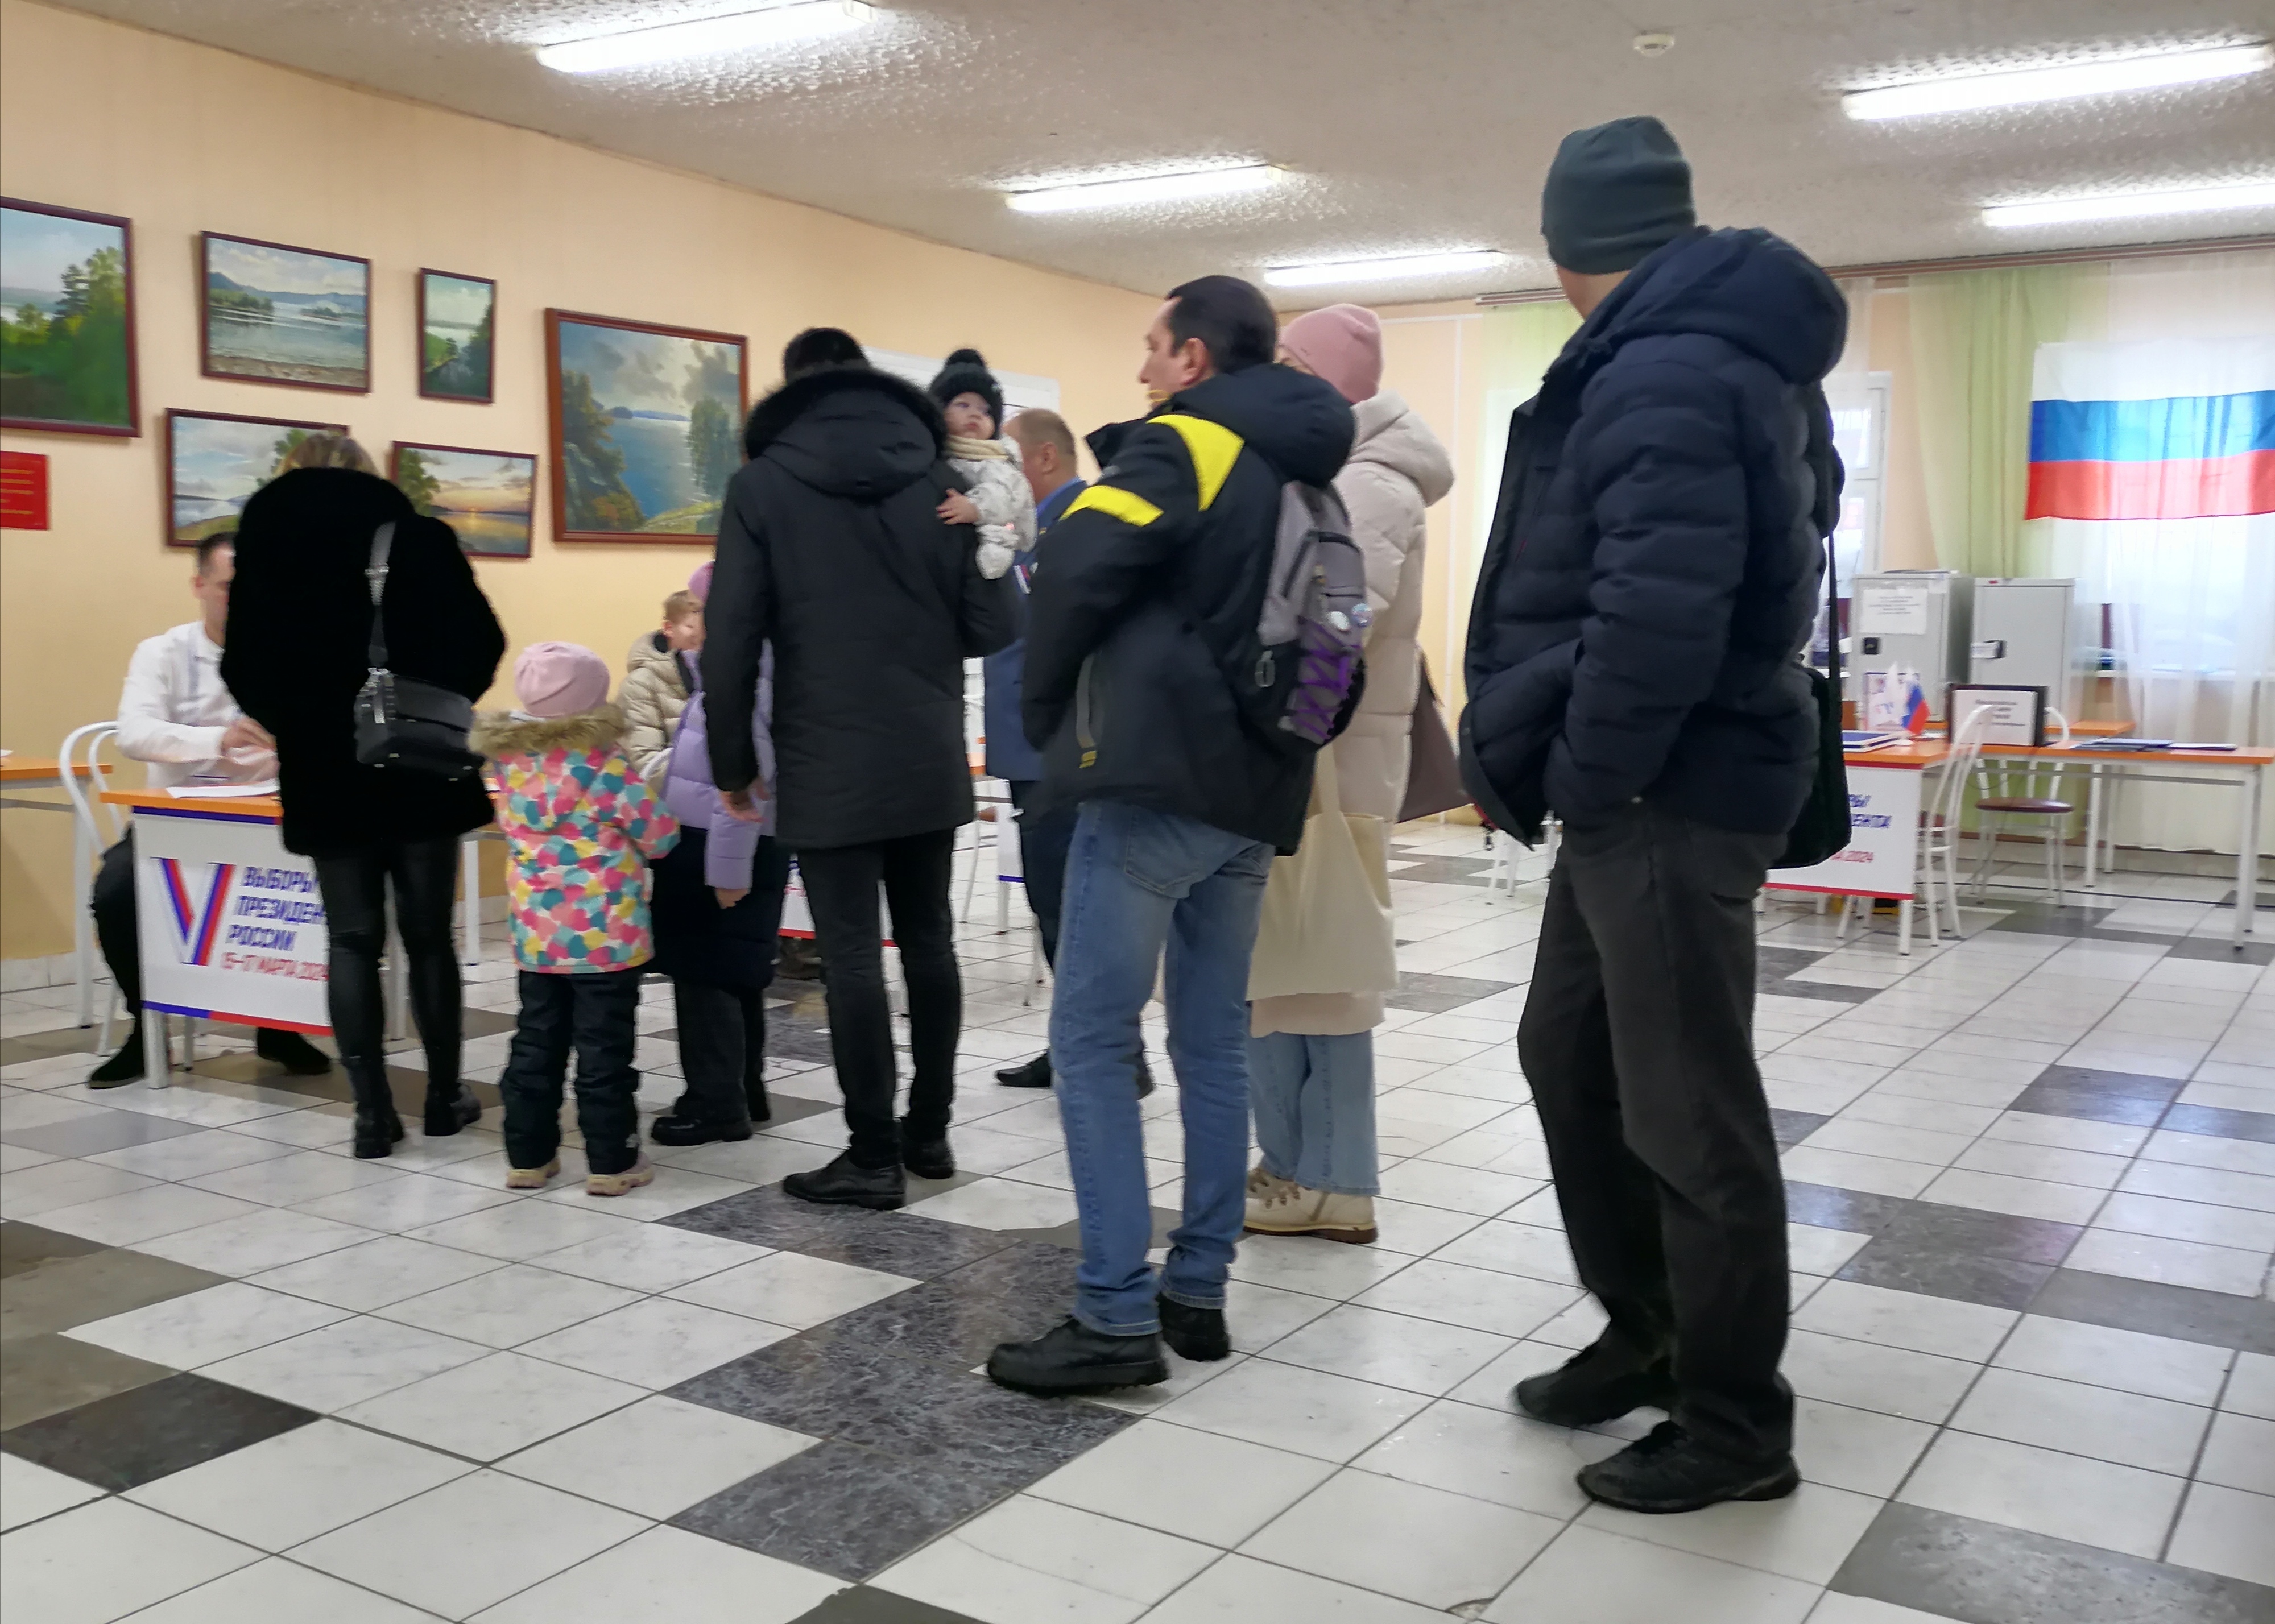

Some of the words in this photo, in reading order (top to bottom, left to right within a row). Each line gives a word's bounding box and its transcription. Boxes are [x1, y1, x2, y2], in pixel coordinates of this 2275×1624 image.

[233, 895, 326, 925] ПРЕЗИДЕН
[225, 925, 297, 951] РОССИИ
[257, 955, 297, 978] МАРТА
